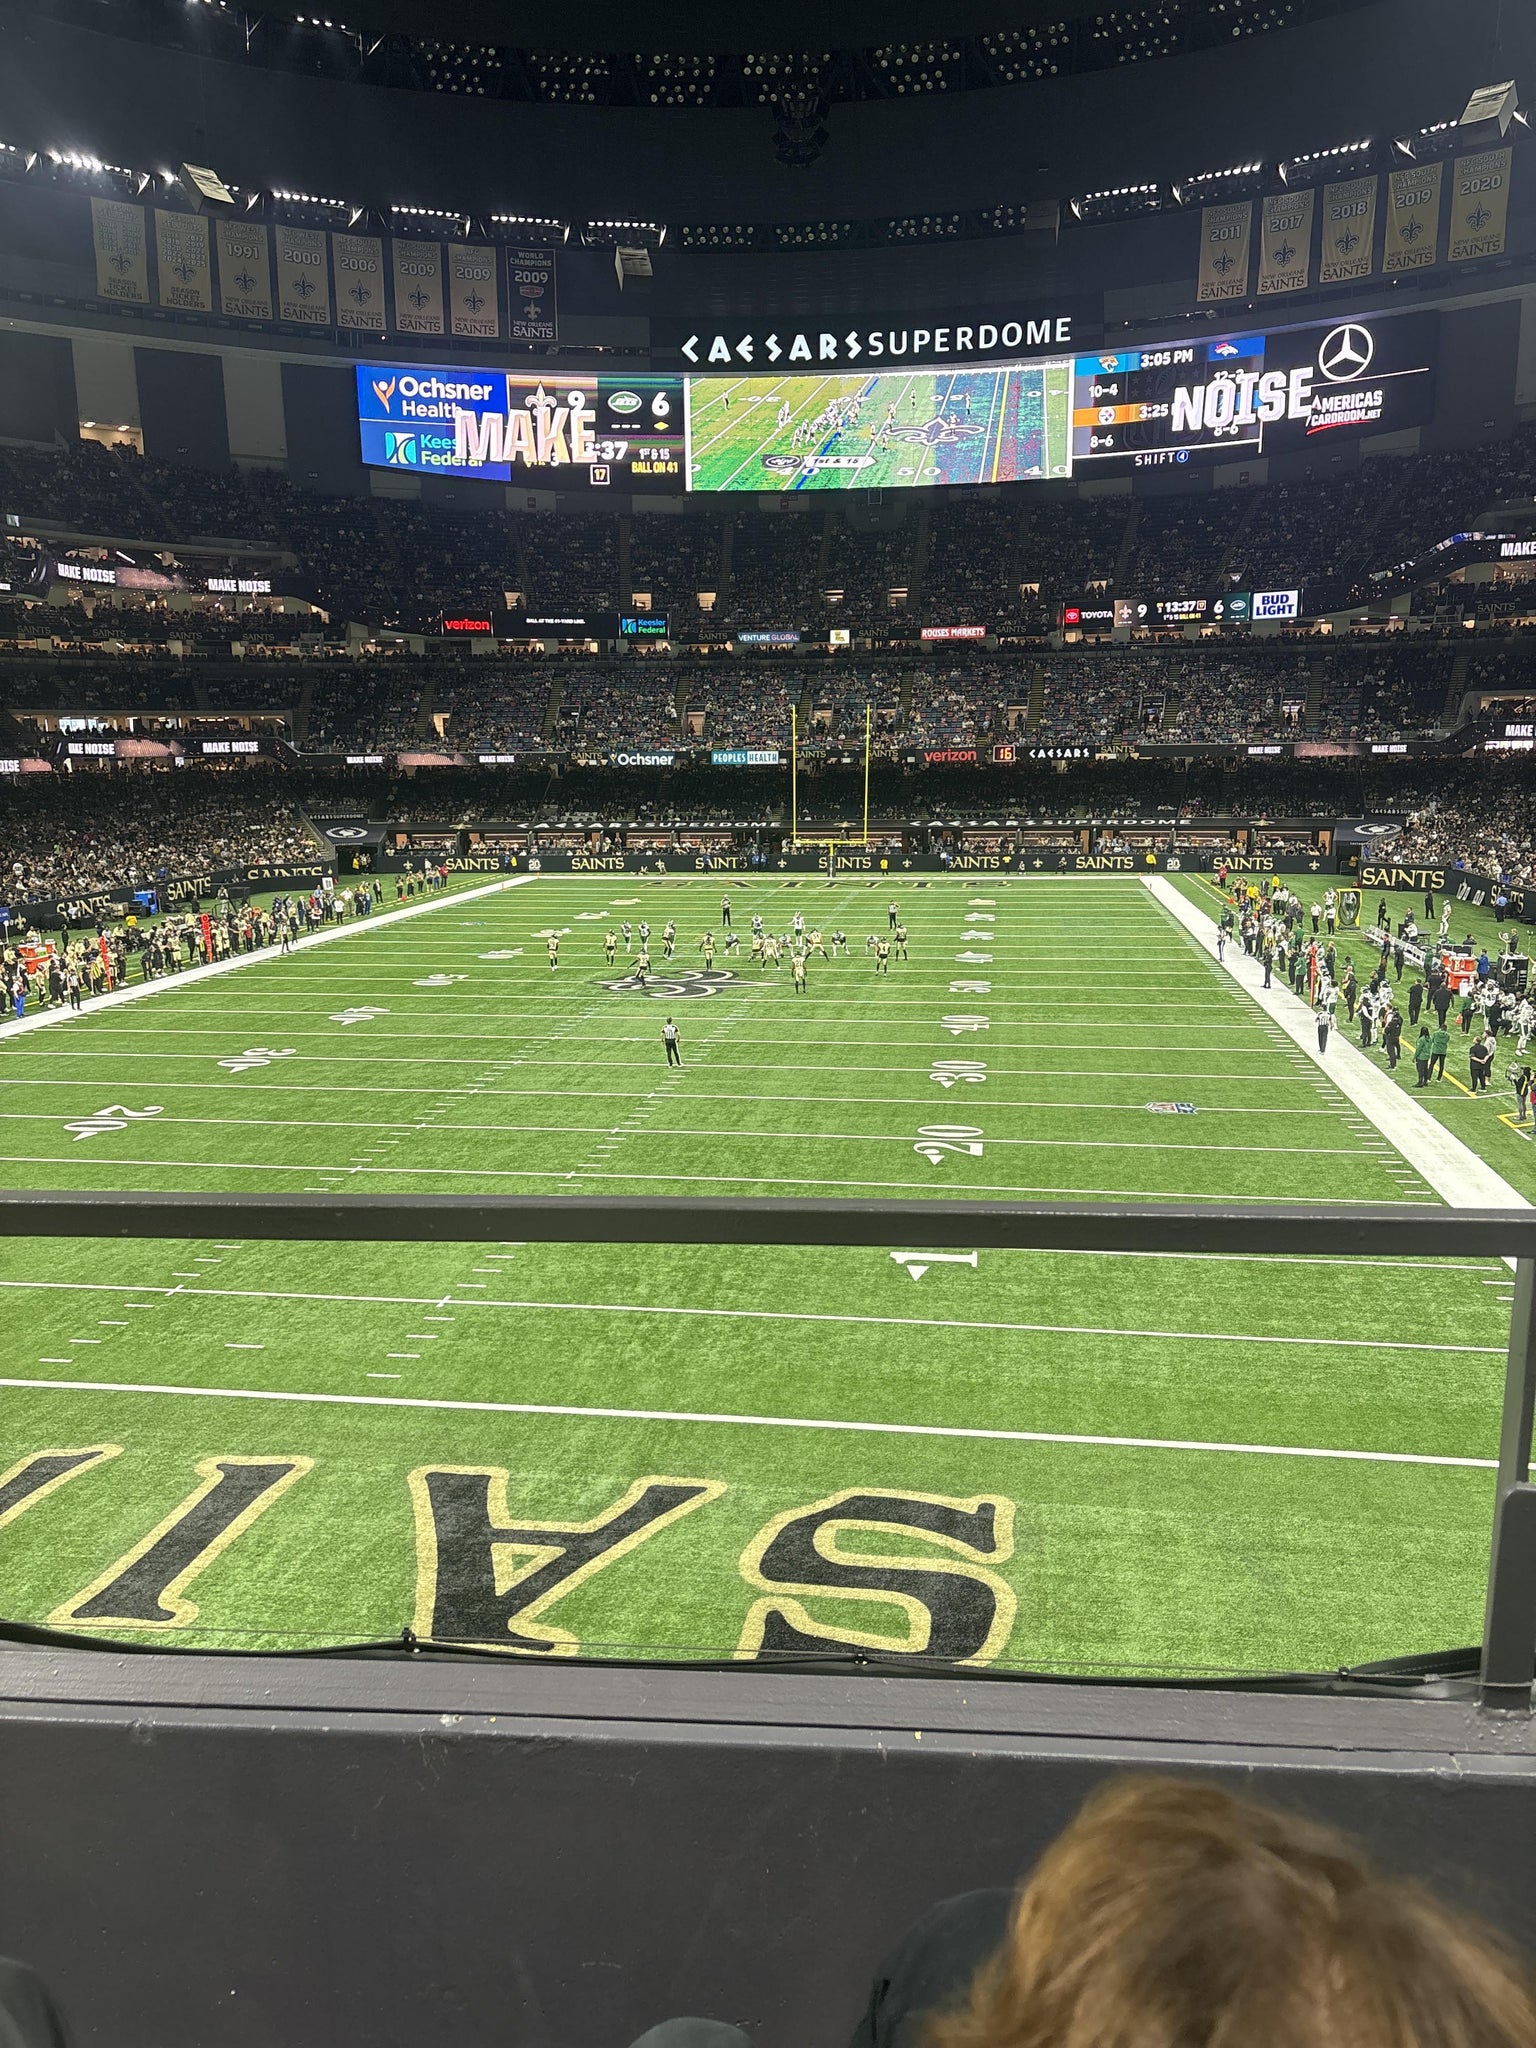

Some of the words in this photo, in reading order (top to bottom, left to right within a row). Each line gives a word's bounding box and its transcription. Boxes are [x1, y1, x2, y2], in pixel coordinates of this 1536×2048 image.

[1460, 176, 1502, 195] 2020
[1395, 190, 1432, 209] 2019
[1330, 202, 1368, 221] 2018
[1270, 214, 1304, 232] 2017
[1210, 226, 1242, 242] 2011
[226, 242, 260, 259] 1991
[1452, 240, 1500, 258] SAINTS
[283, 250, 322, 265] 2000
[510, 258, 552, 266] CHAMPIONS
[1386, 252, 1433, 270] SAINTS
[340, 257, 377, 272] 2006
[400, 262, 435, 276] 2009
[455, 266, 491, 281] 2009
[514, 270, 548, 283] 2009
[1323, 263, 1368, 280] SAINTS
[1261, 276, 1304, 292] SAINTS
[104, 289, 142, 300] HOLDERS
[1201, 284, 1243, 299] SAINTS
[166, 297, 205, 308] HOLDERS
[225, 303, 269, 316] SAINTS
[283, 308, 327, 322] SAINTS
[340, 314, 383, 328] SAINTS
[400, 319, 440, 332] SAINTS
[454, 323, 495, 335] SAINTS
[513, 326, 553, 338] SAINTS
[681, 331, 862, 363] CAESARS
[868, 317, 1072, 356] SUPERDOME
[1140, 352, 1171, 368] 3:05
[1174, 349, 1193, 364] PM
[399, 376, 492, 400] Ochsner
[1088, 384, 1118, 398] 10-4
[568, 390, 586, 411] 9
[651, 392, 670, 416] 6
[1172, 367, 1314, 431] NOISE
[1312, 390, 1382, 411] AMERICAS
[1139, 404, 1169, 419] 3:25
[454, 408, 596, 464] MAKE
[1091, 435, 1114, 448] 8-6
[581, 441, 628, 460] 3:37
[659, 448, 670, 460] 15
[632, 462, 652, 473] BALL
[653, 462, 666, 473] ON
[667, 462, 678, 473] 41
[897, 466, 942, 476] 50
[594, 469, 605, 480] 17
[1500, 541, 1536, 557] MAKE
[82, 567, 116, 583] NOISE
[208, 579, 237, 592] MAKE
[238, 580, 271, 593] NOISE
[1262, 594, 1289, 605] BUD
[1138, 604, 1147, 617] 9
[1165, 601, 1196, 612] 13:37
[1214, 600, 1224, 613] 6
[1256, 604, 1294, 616] LIGHT
[1478, 603, 1516, 613] SAINTS
[1081, 610, 1113, 619] TOYOTA
[18, 626, 52, 635] SAINTS
[445, 618, 490, 630] verizon
[92, 629, 126, 638] SAINTS
[922, 629, 950, 637] ROUSES
[951, 628, 985, 636] MARKETS
[1505, 724, 1534, 736] MAKE
[85, 744, 115, 755] NOISE
[202, 742, 230, 753] MAKE
[232, 741, 258, 752] NOISE
[1029, 747, 1090, 758] CAESARS
[1100, 745, 1135, 754] SAINTS
[571, 752, 602, 761] SAINTS
[618, 753, 674, 766] Ochsner
[713, 754, 746, 762] PEOPLES
[748, 754, 778, 763] HEALTH
[924, 749, 976, 762] verizon
[1000, 749, 1012, 760] 16
[446, 858, 499, 870] SAINTS
[528, 859, 541, 869] 20
[571, 857, 624, 869] SAINTS
[819, 857, 871, 868] SINTS
[949, 856, 1000, 869] SAINTS
[1076, 857, 1134, 870] SAINTS
[1167, 858, 1180, 869] 20
[1214, 857, 1273, 870] SAINTS
[1362, 867, 1445, 889] SAINTS
[168, 876, 211, 900] SAINTS
[948, 980, 992, 993] 50
[940, 1015, 990, 1031] 40
[216, 1047, 297, 1070] 30
[929, 1060, 988, 1083] 30
[63, 1105, 164, 1133] 20
[913, 1124, 984, 1156] 20
[890, 1250, 978, 1268] 1
